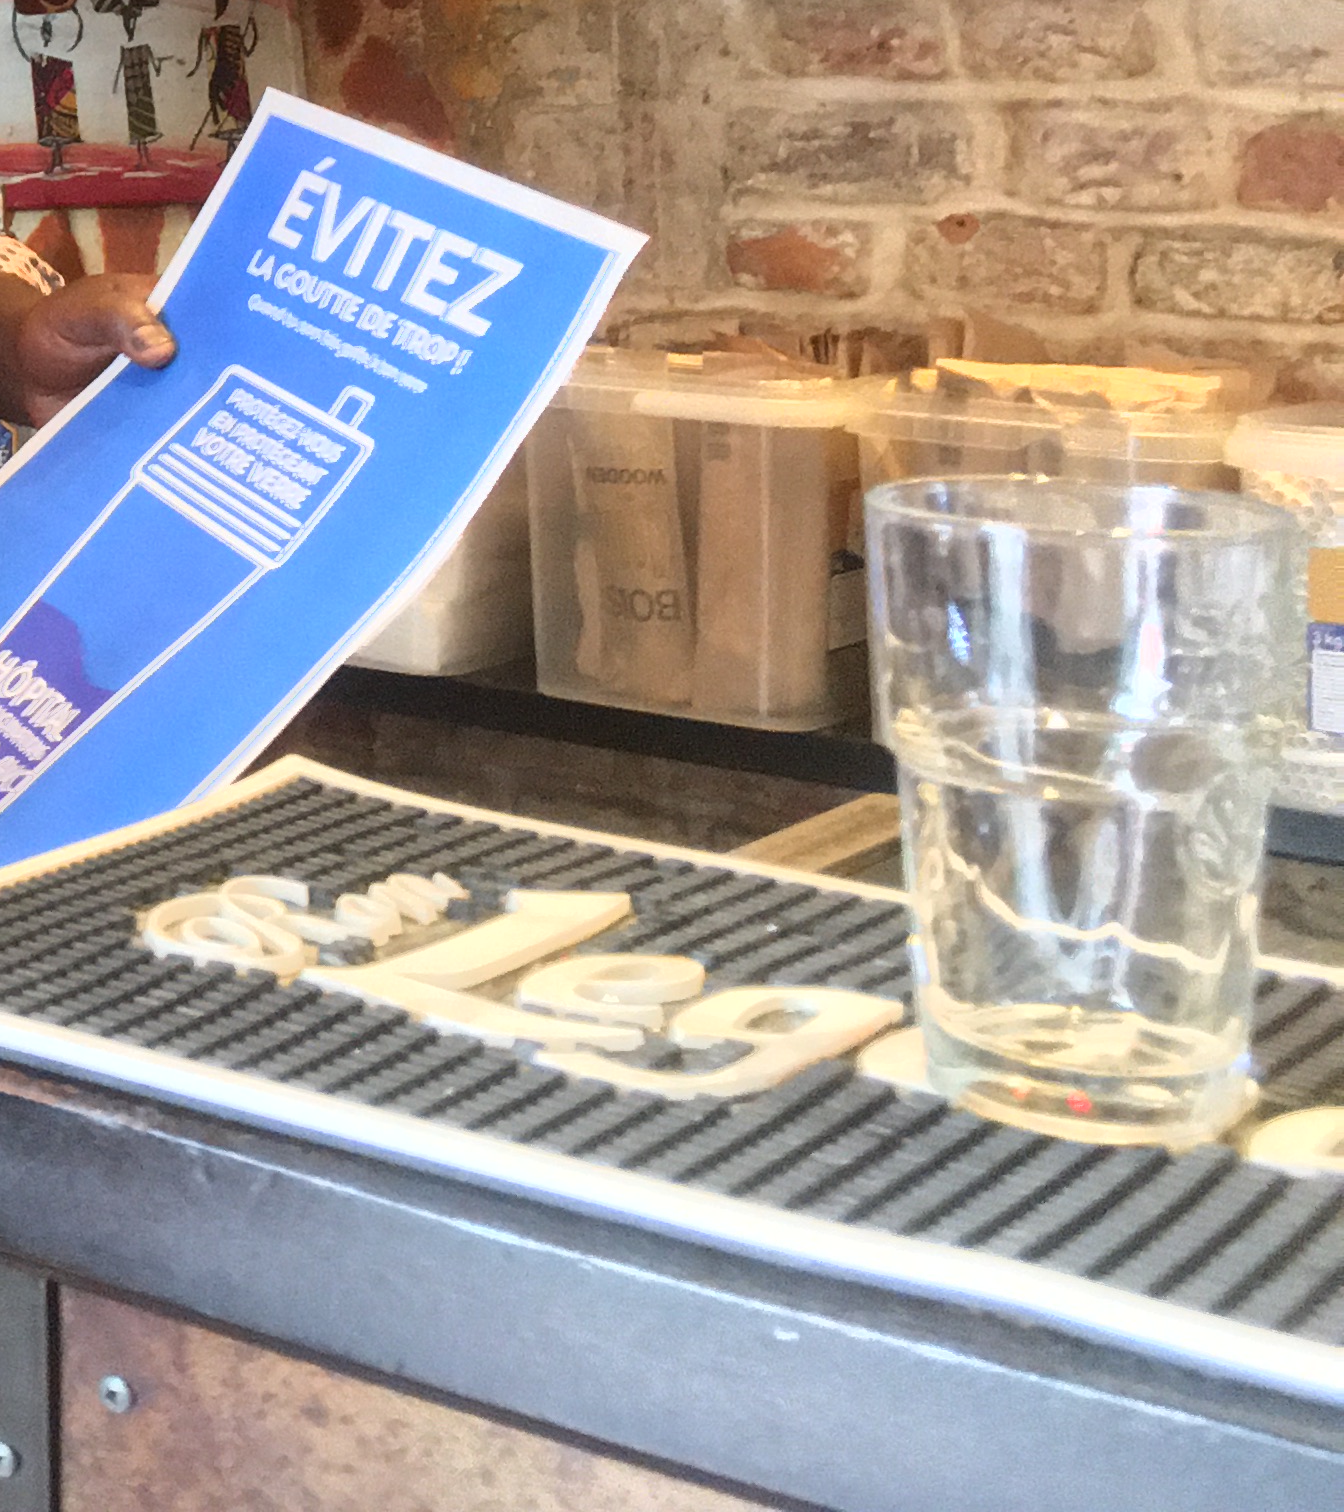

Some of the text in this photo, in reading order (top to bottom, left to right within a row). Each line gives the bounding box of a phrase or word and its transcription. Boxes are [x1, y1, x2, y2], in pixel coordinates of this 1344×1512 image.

[267, 157, 525, 338] ÉVITEZ
[246, 248, 276, 282] LA
[273, 262, 365, 323] GOUTTE
[355, 303, 399, 339] DE
[190, 426, 312, 510] VOTRE VERRE
